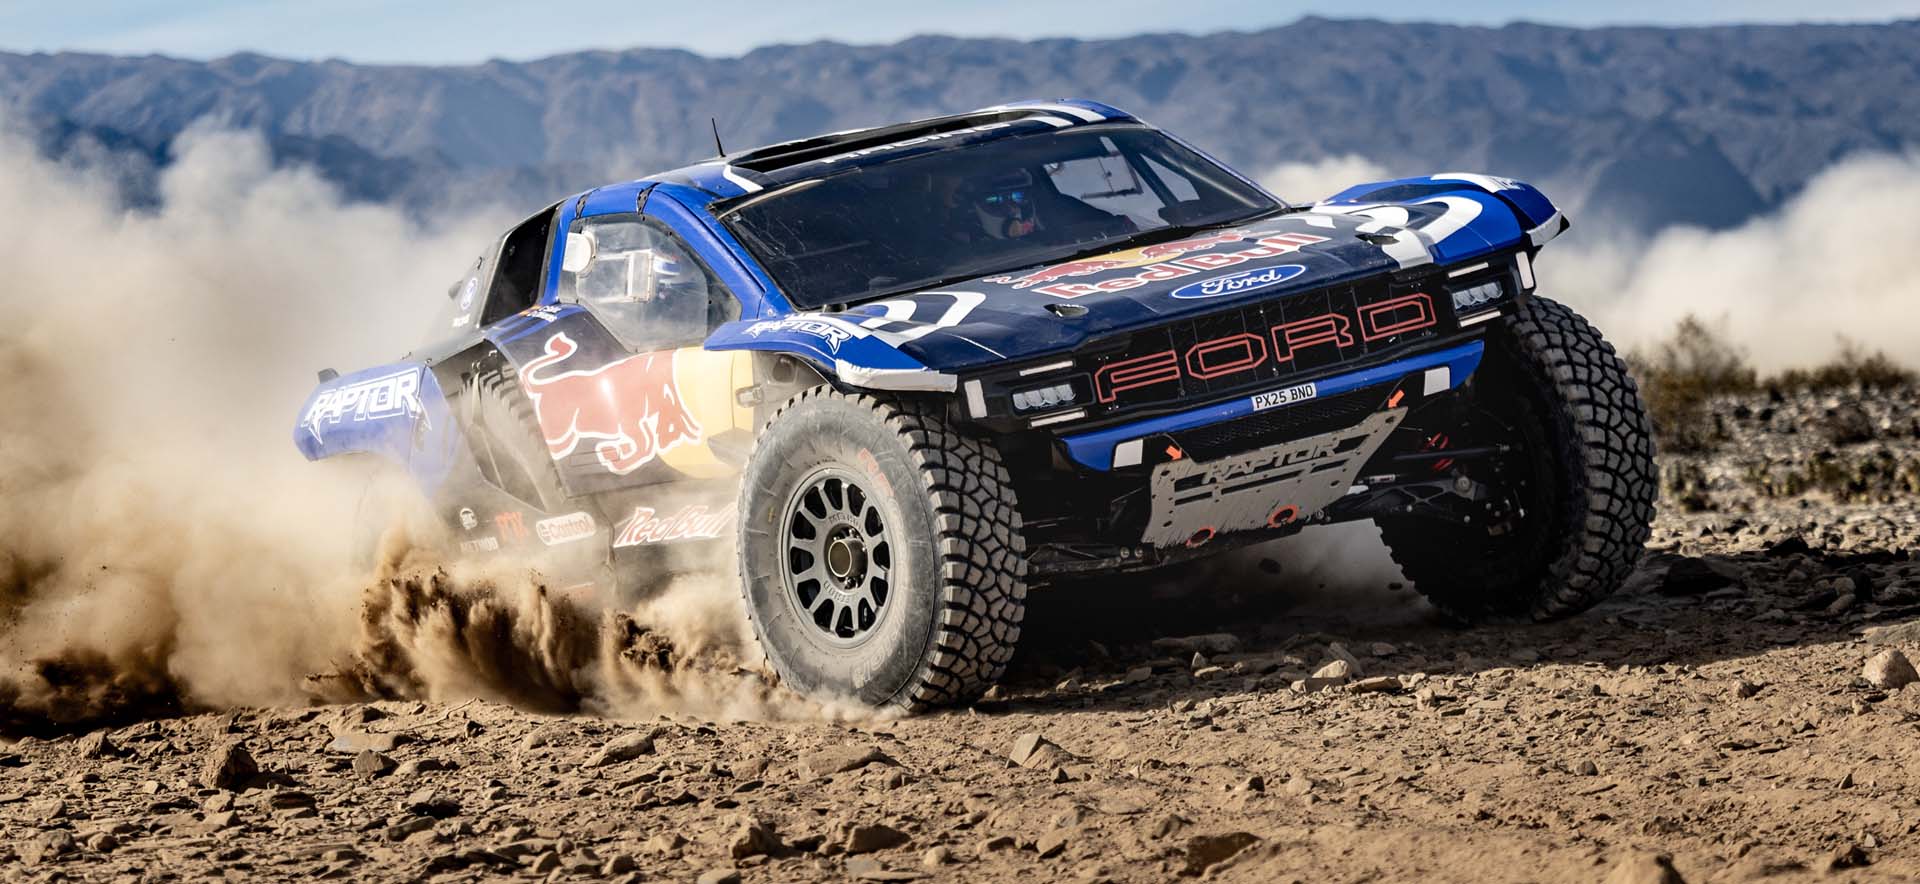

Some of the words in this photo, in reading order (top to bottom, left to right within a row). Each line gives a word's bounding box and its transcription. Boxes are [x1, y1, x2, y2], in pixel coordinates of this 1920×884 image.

[741, 319, 853, 355] RAPTOR
[1095, 293, 1436, 403] FORD
[300, 367, 432, 445] RAPTOR
[1255, 390, 1287, 408] PX25
[1201, 437, 1341, 485] RAPTOR
